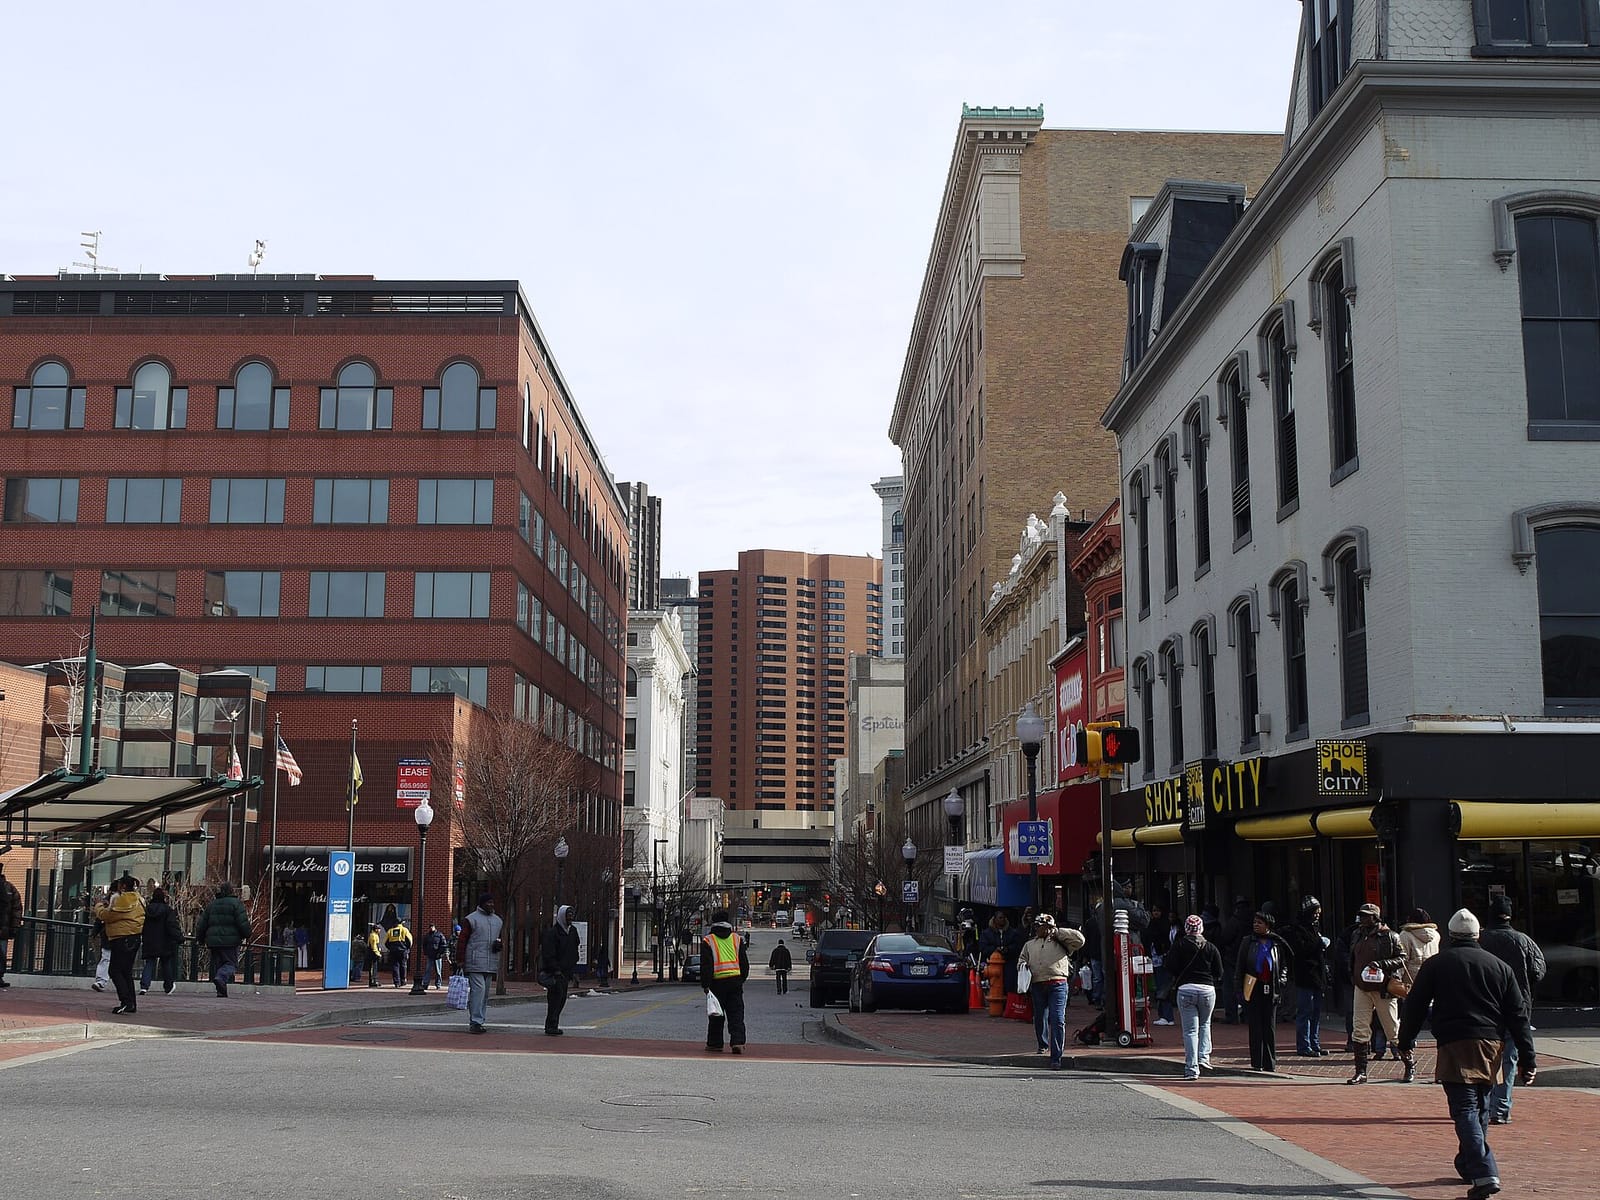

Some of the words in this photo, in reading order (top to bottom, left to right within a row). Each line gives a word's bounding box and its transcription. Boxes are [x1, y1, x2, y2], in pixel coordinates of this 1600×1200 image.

[1321, 745, 1363, 758] SHOE
[400, 768, 428, 776] LEASE
[1187, 766, 1202, 785] SHOE
[1145, 778, 1183, 823] SHOE
[1211, 757, 1262, 814] CITY
[1324, 777, 1362, 791] CITY
[1190, 806, 1203, 823] CITY
[337, 863, 346, 872] M
